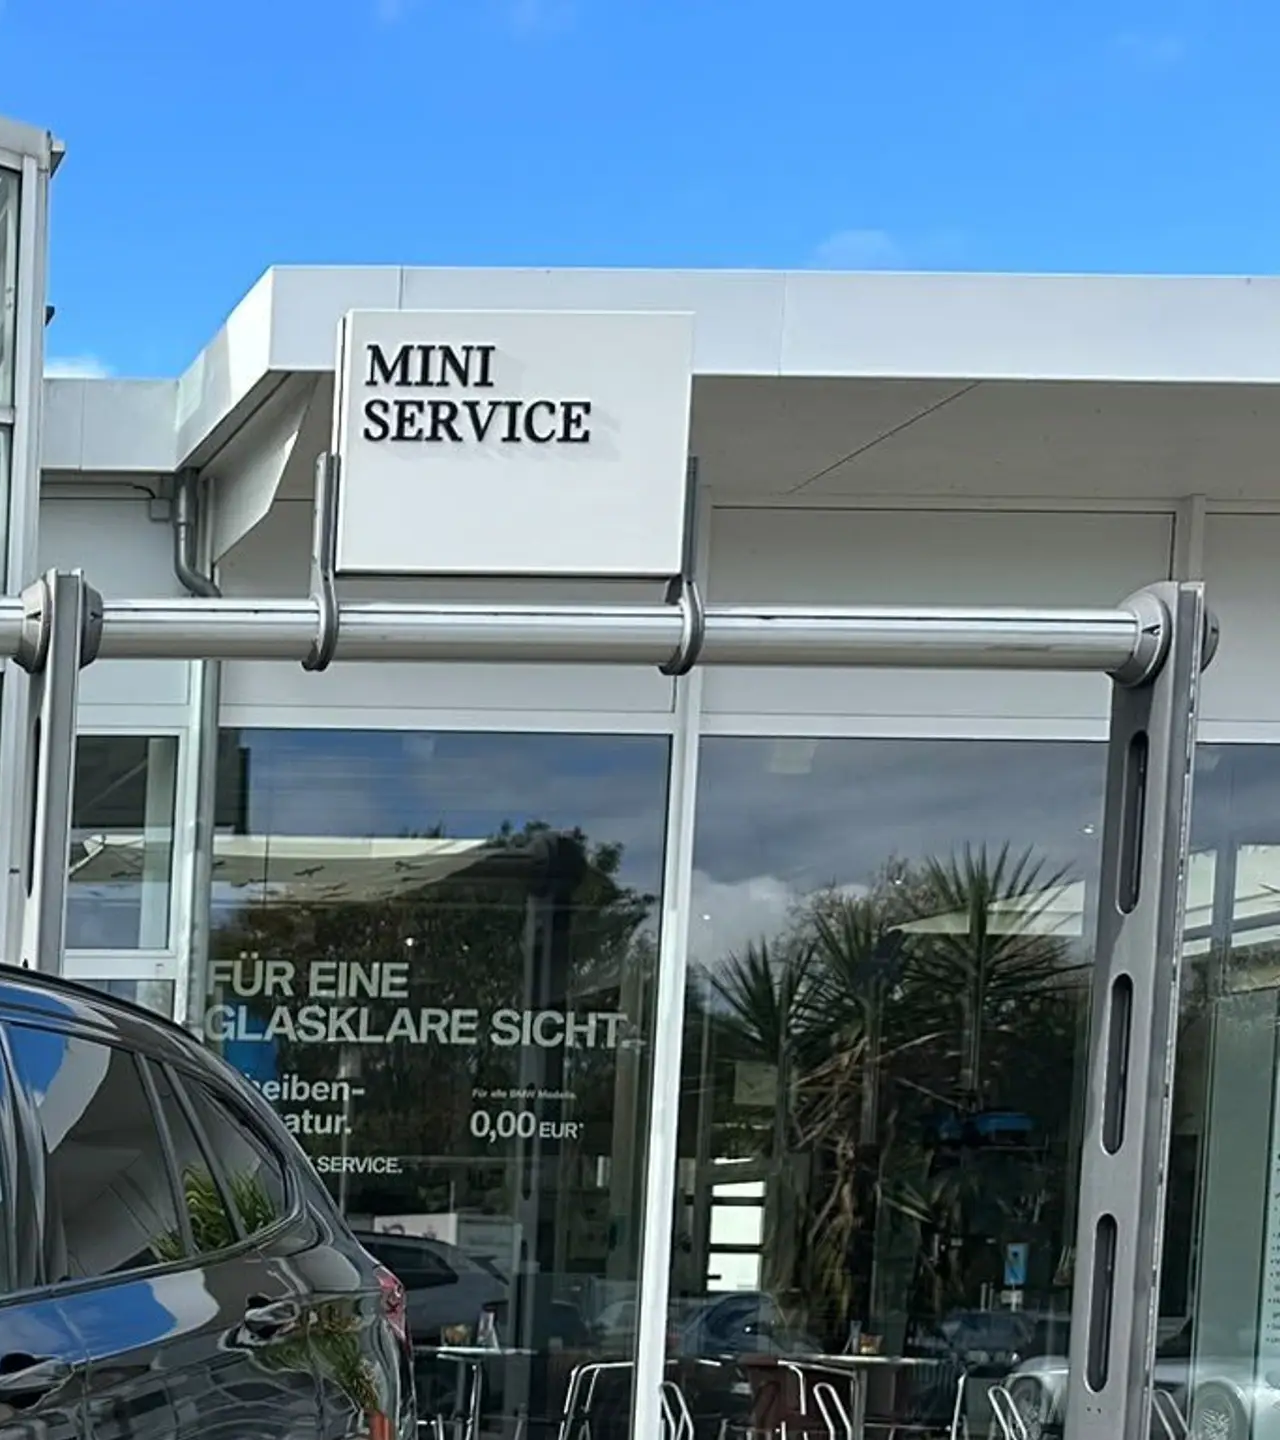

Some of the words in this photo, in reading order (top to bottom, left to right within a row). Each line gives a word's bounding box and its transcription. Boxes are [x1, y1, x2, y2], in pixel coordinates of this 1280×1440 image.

[364, 344, 496, 388] MINI
[362, 398, 592, 443] SERVICE
[206, 952, 296, 998] FÜR
[308, 960, 410, 1000] EINE
[204, 1004, 478, 1045] GLASKLARE
[282, 1109, 353, 1135] atur.
[470, 1110, 537, 1144] 0,00
[316, 1156, 404, 1174] SERVICE.
